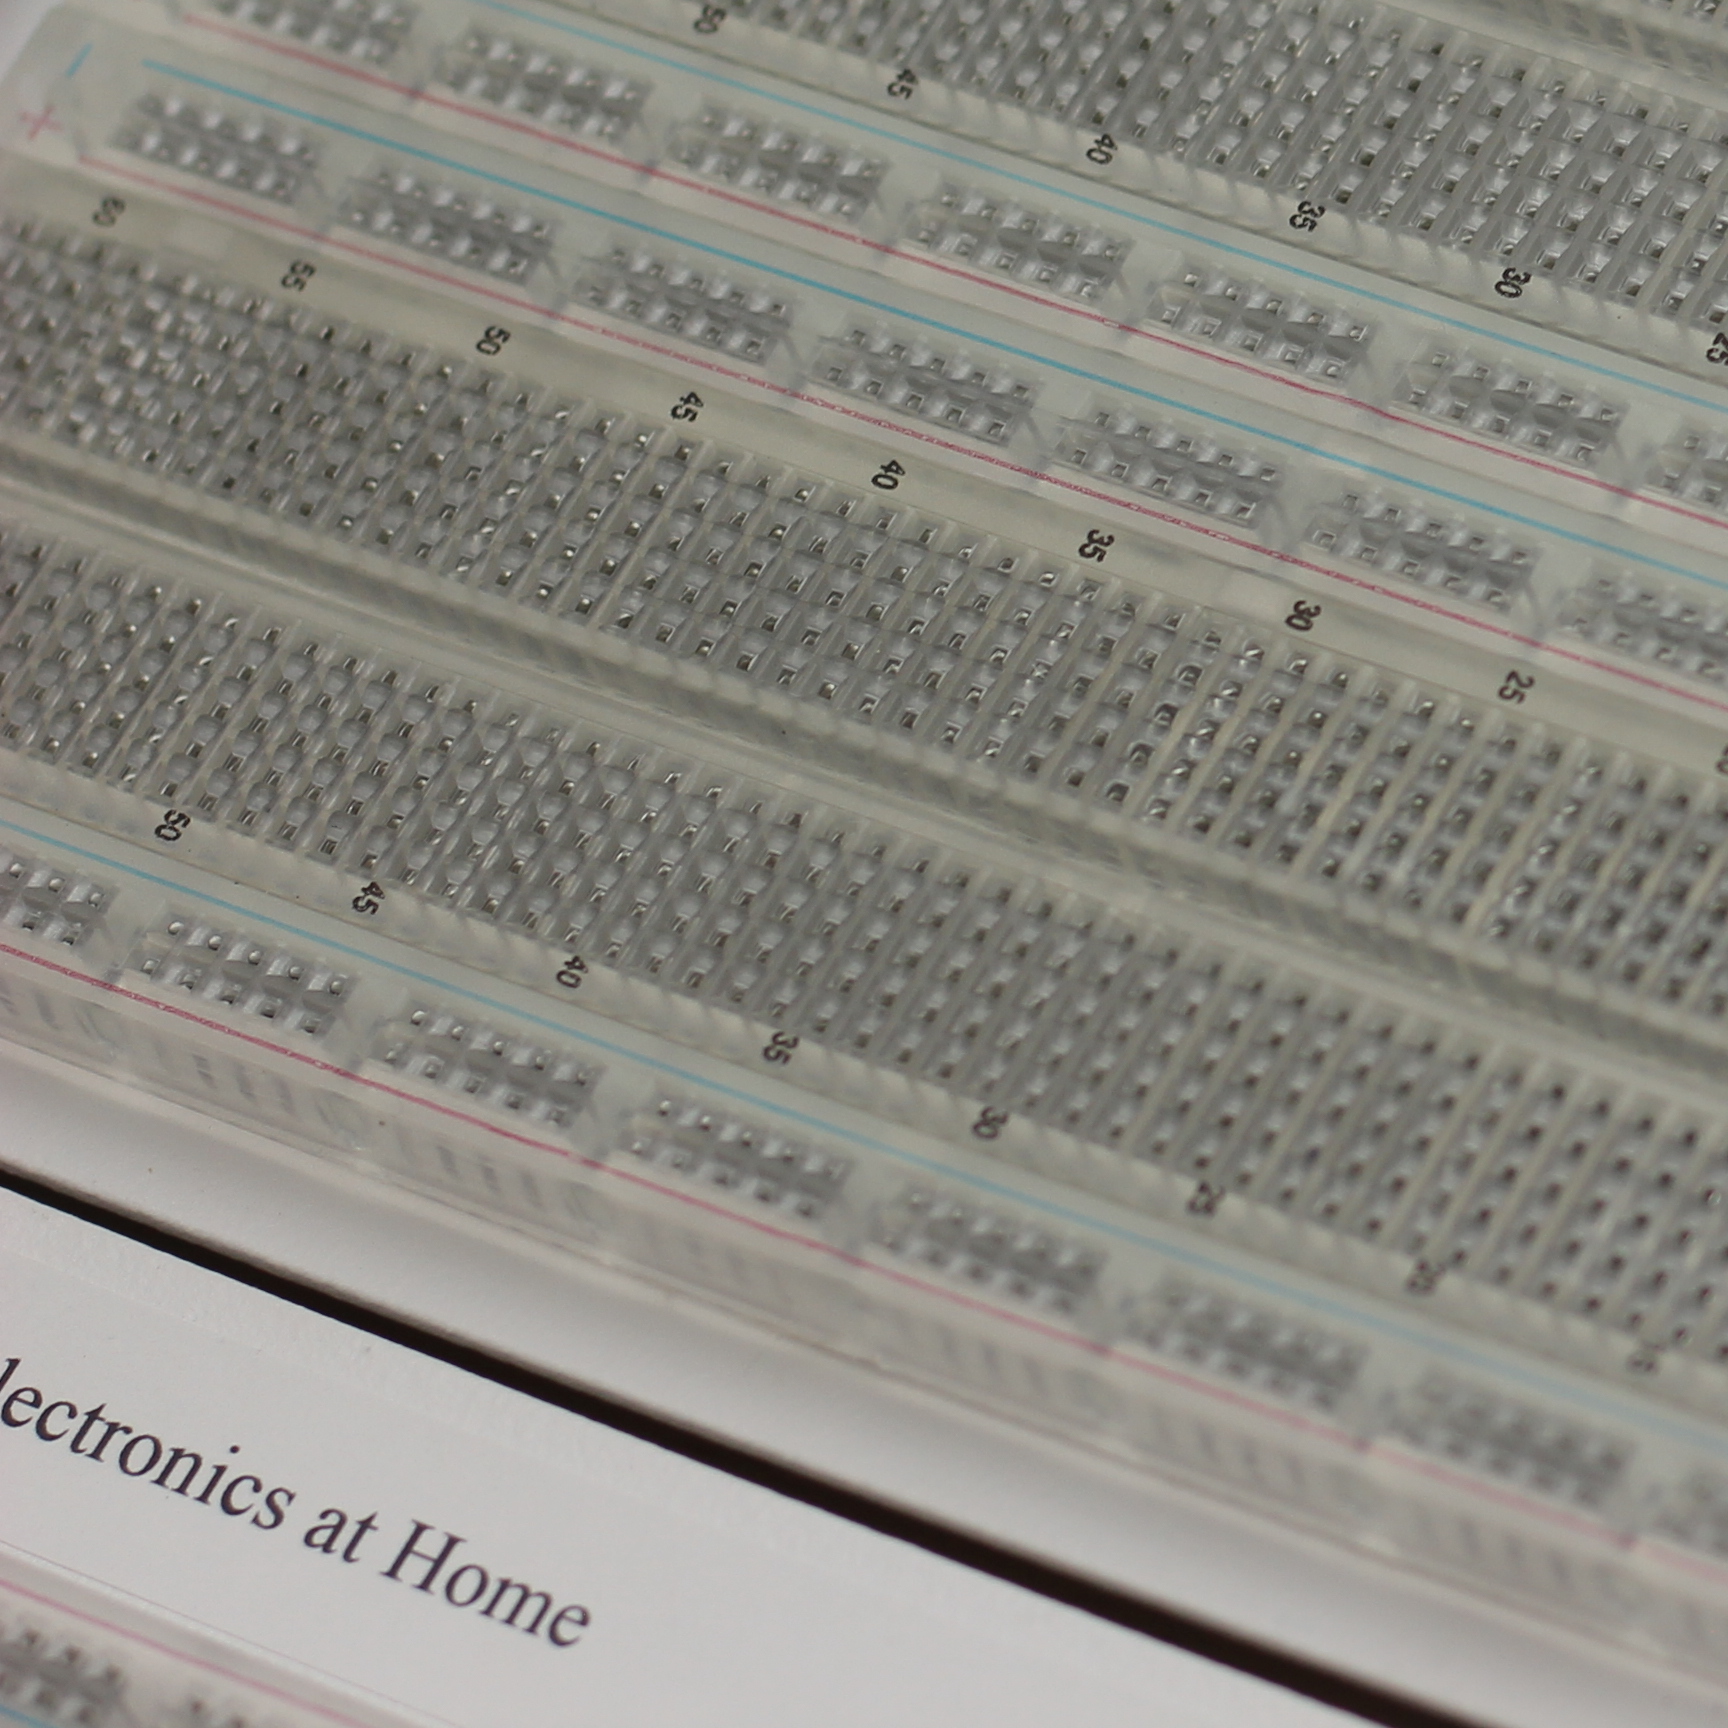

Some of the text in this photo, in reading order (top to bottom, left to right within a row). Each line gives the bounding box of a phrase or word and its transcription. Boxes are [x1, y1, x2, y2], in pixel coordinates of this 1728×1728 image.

[886, 67, 920, 102] 45
[1085, 132, 1120, 166] 40
[1288, 200, 1327, 234] 35
[1493, 266, 1532, 300] 30
[475, 324, 512, 358] 50
[669, 391, 705, 423] 45
[871, 458, 907, 491] 40
[1078, 528, 1116, 564] 35
[1284, 599, 1322, 632] 30
[1497, 668, 1536, 706] 25
[154, 808, 192, 842] 50
[350, 880, 388, 917] 45
[555, 954, 590, 989] 40
[762, 1030, 799, 1065] 35
[971, 1105, 1010, 1141] 30
[302, 1502, 382, 1566] at
[380, 1518, 594, 1650] Home
